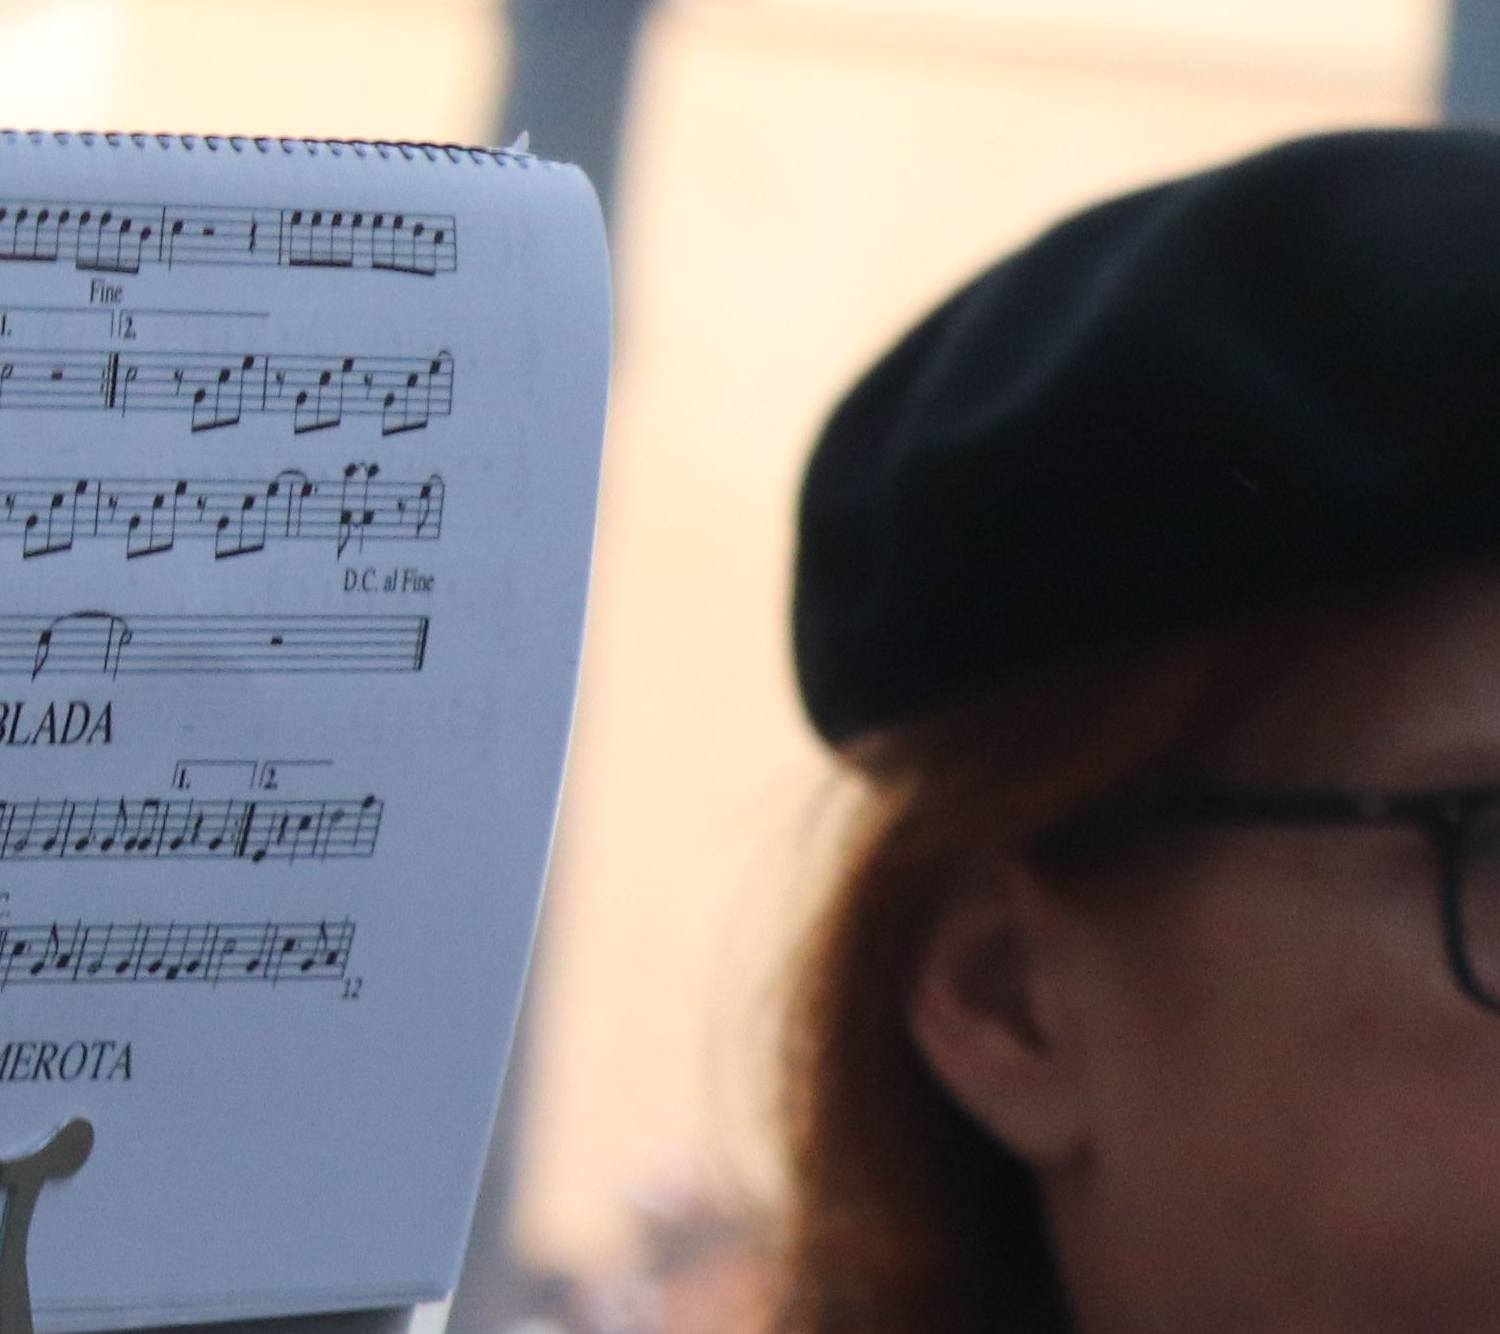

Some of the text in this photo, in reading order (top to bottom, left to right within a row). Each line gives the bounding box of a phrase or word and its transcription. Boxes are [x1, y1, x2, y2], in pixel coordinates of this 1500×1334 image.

[88, 278, 124, 304] Fine
[343, 568, 436, 593] D.C. al Fine
